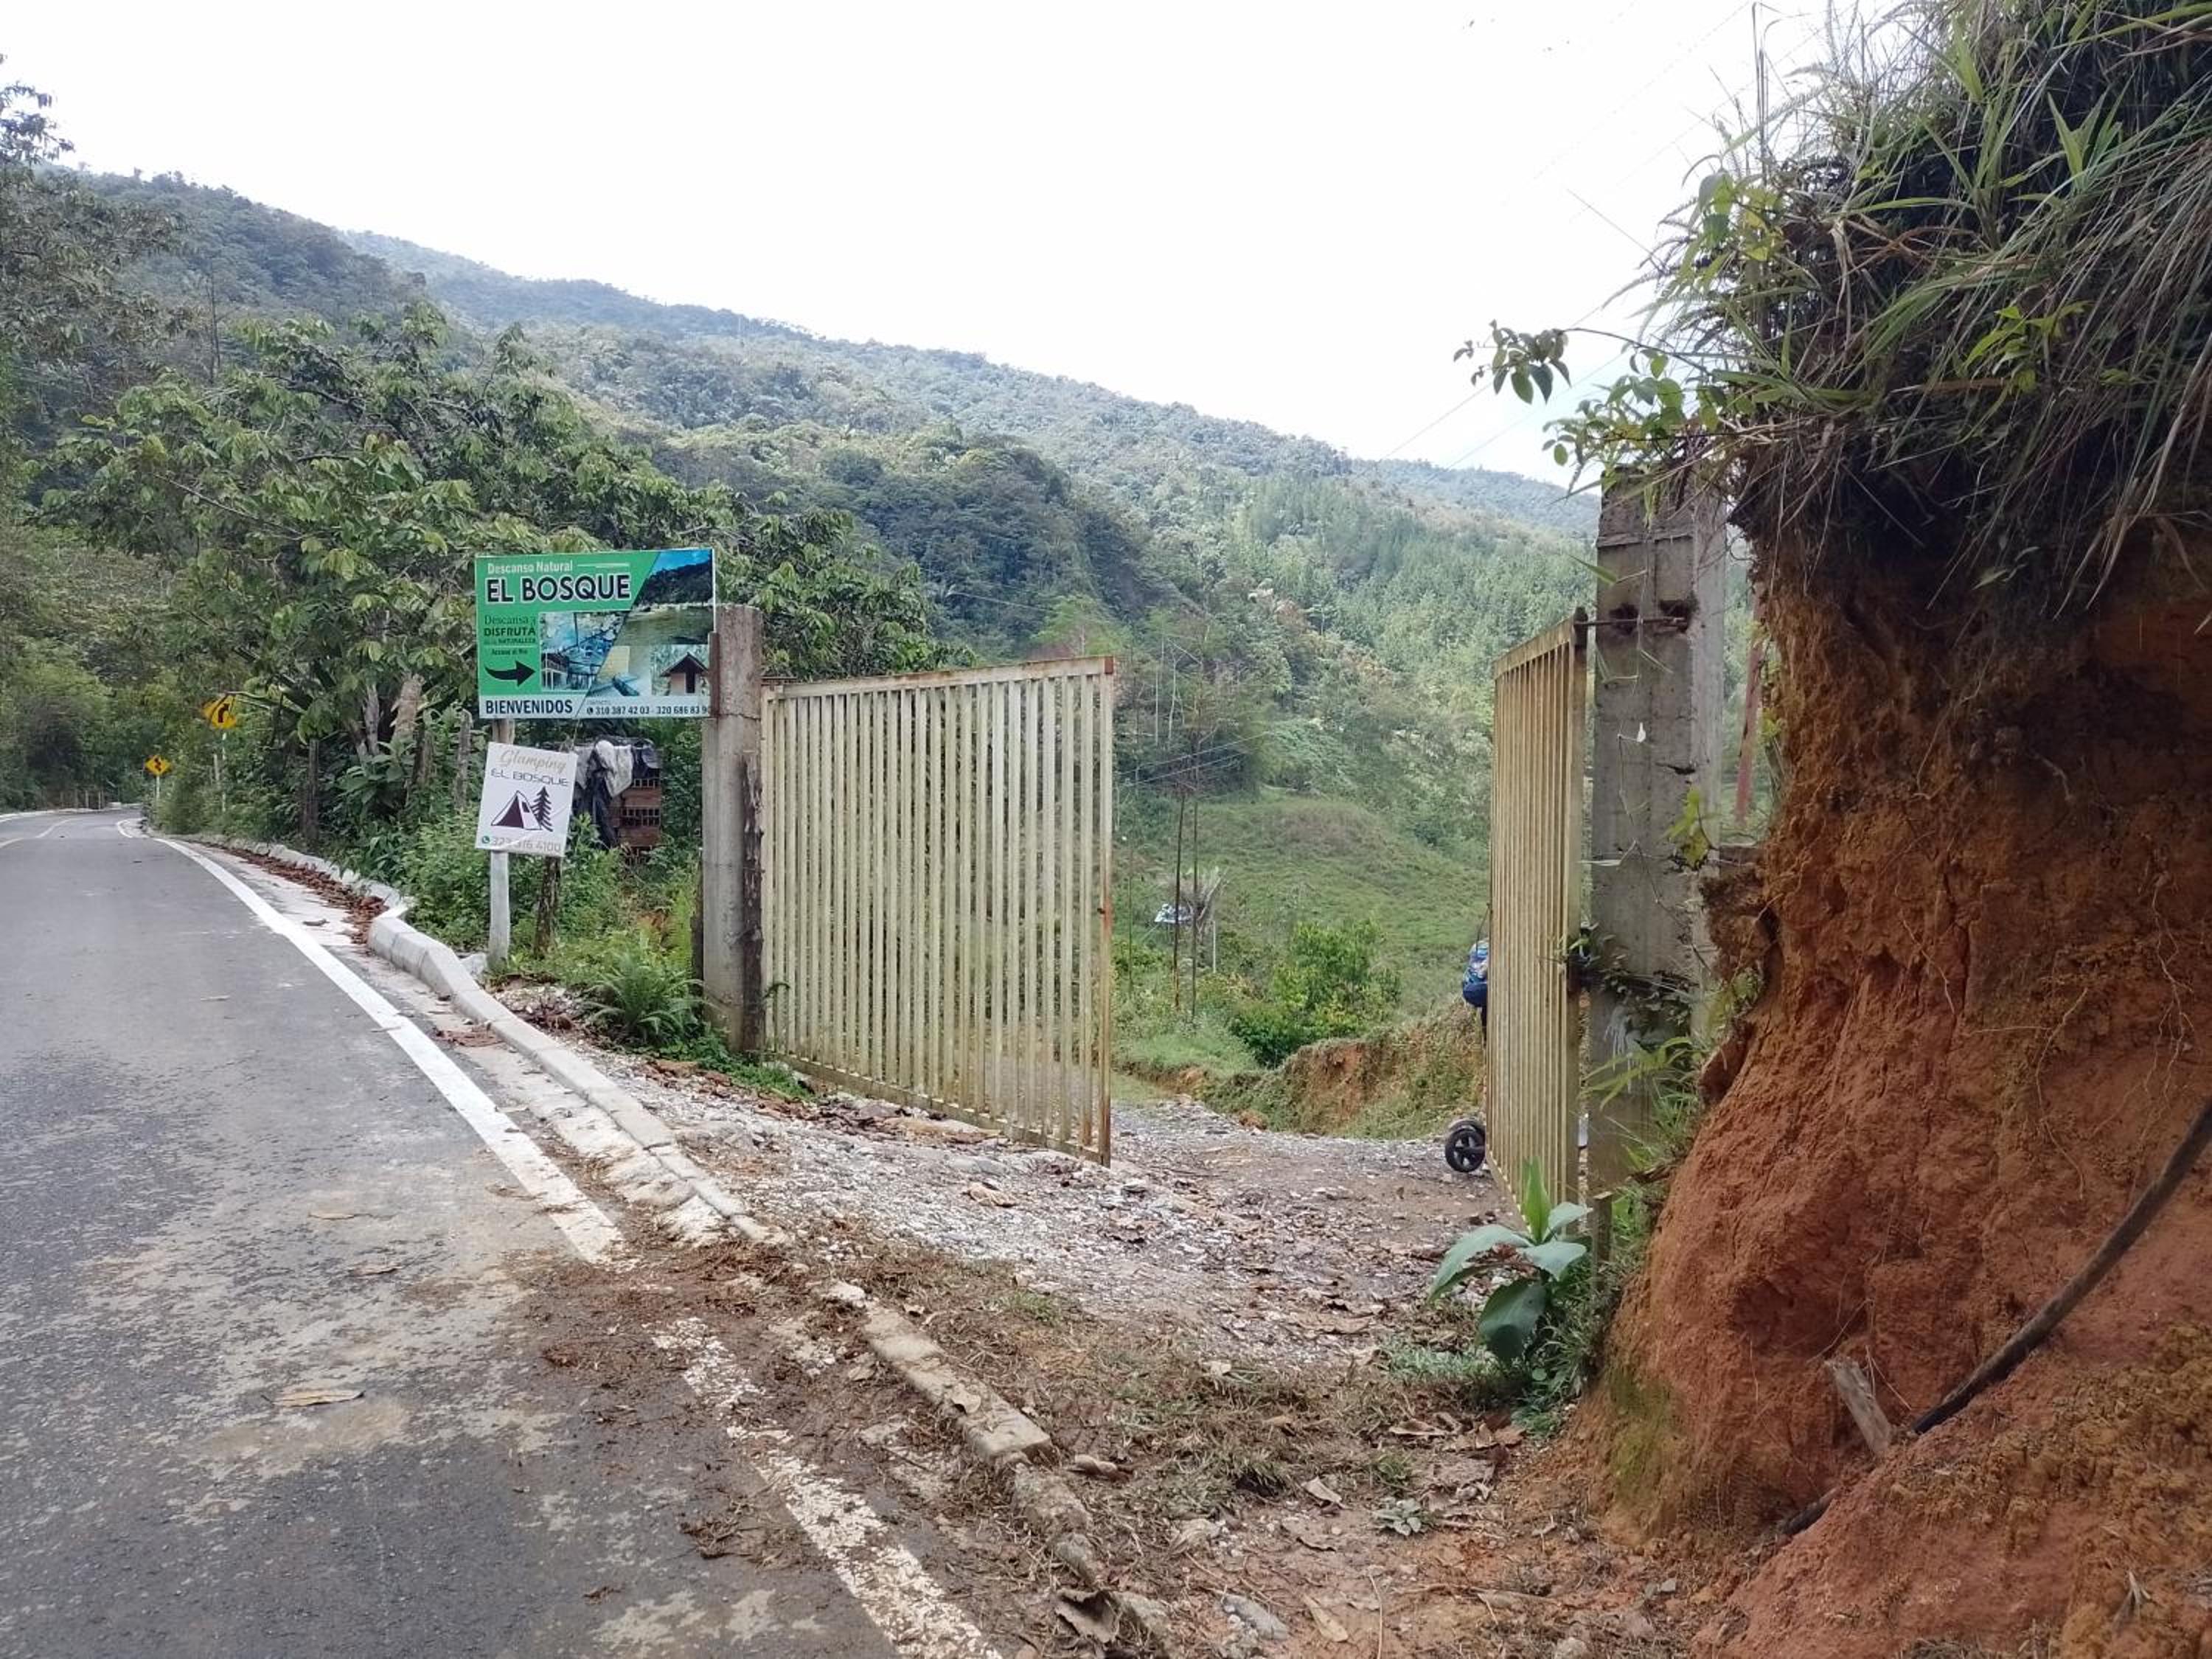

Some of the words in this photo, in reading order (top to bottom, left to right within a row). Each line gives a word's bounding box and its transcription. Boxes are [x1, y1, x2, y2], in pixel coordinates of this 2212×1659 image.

[487, 562, 535, 575] Descanso
[536, 560, 573, 573] Natural
[485, 577, 515, 604] EL
[521, 574, 631, 603] BOSQUE
[484, 627, 536, 636] DISFRUTA
[485, 699, 573, 714] BIENVENIDOS
[495, 749, 568, 773] Glamping
[490, 768, 509, 779] EL
[512, 771, 570, 787] BOSQUE
